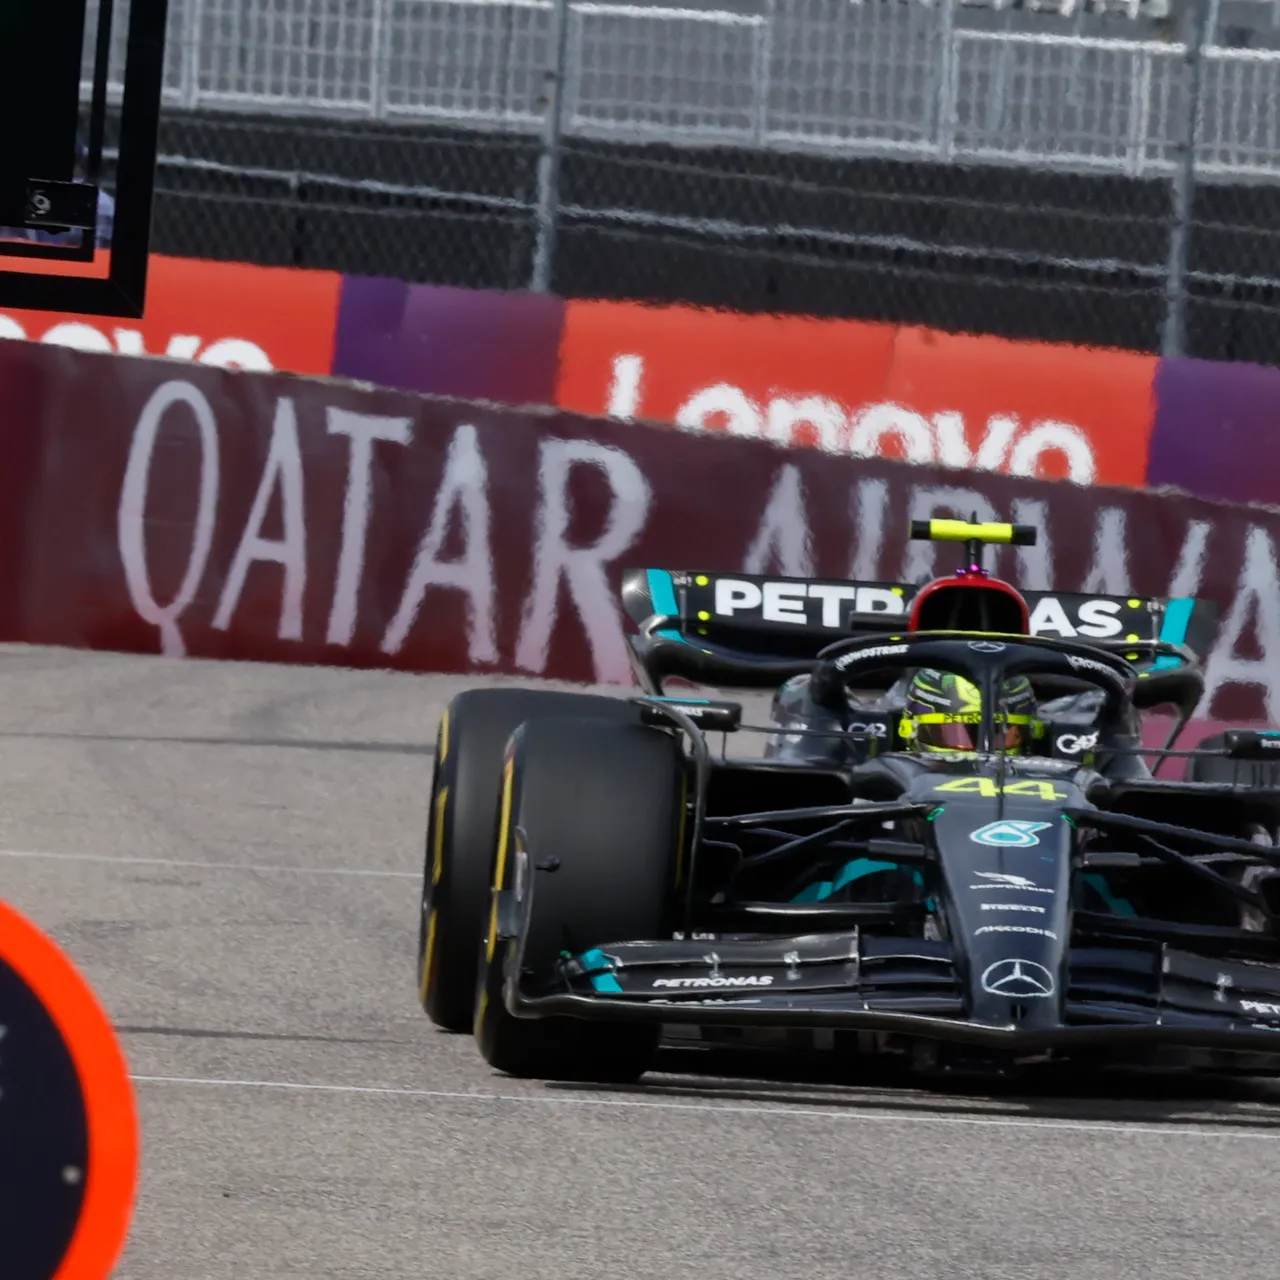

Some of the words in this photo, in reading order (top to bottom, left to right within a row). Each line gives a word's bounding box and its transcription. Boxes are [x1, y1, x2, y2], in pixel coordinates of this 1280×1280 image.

[118, 380, 652, 686] QATAR
[714, 579, 1123, 637] PETRAS
[934, 777, 1067, 800] 44
[652, 975, 775, 988] PETRONAS
